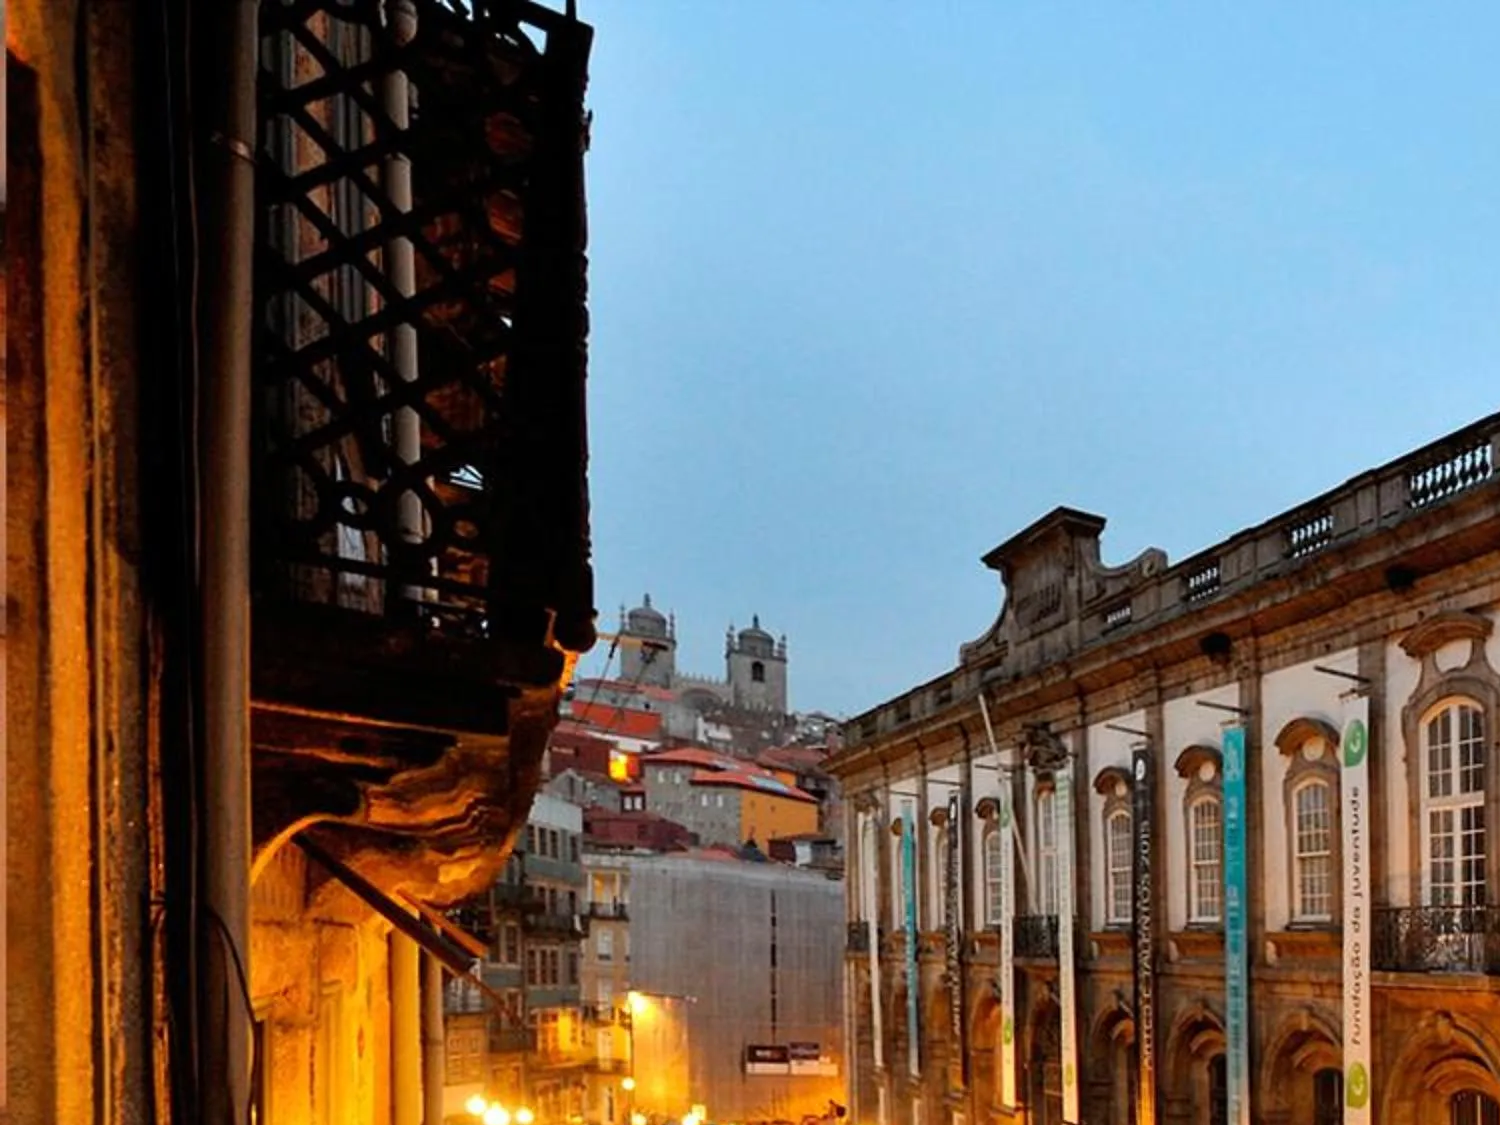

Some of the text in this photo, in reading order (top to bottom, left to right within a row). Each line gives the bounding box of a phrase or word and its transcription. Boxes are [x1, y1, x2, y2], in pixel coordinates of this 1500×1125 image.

[1350, 786, 1364, 1045] fundação da juventude
